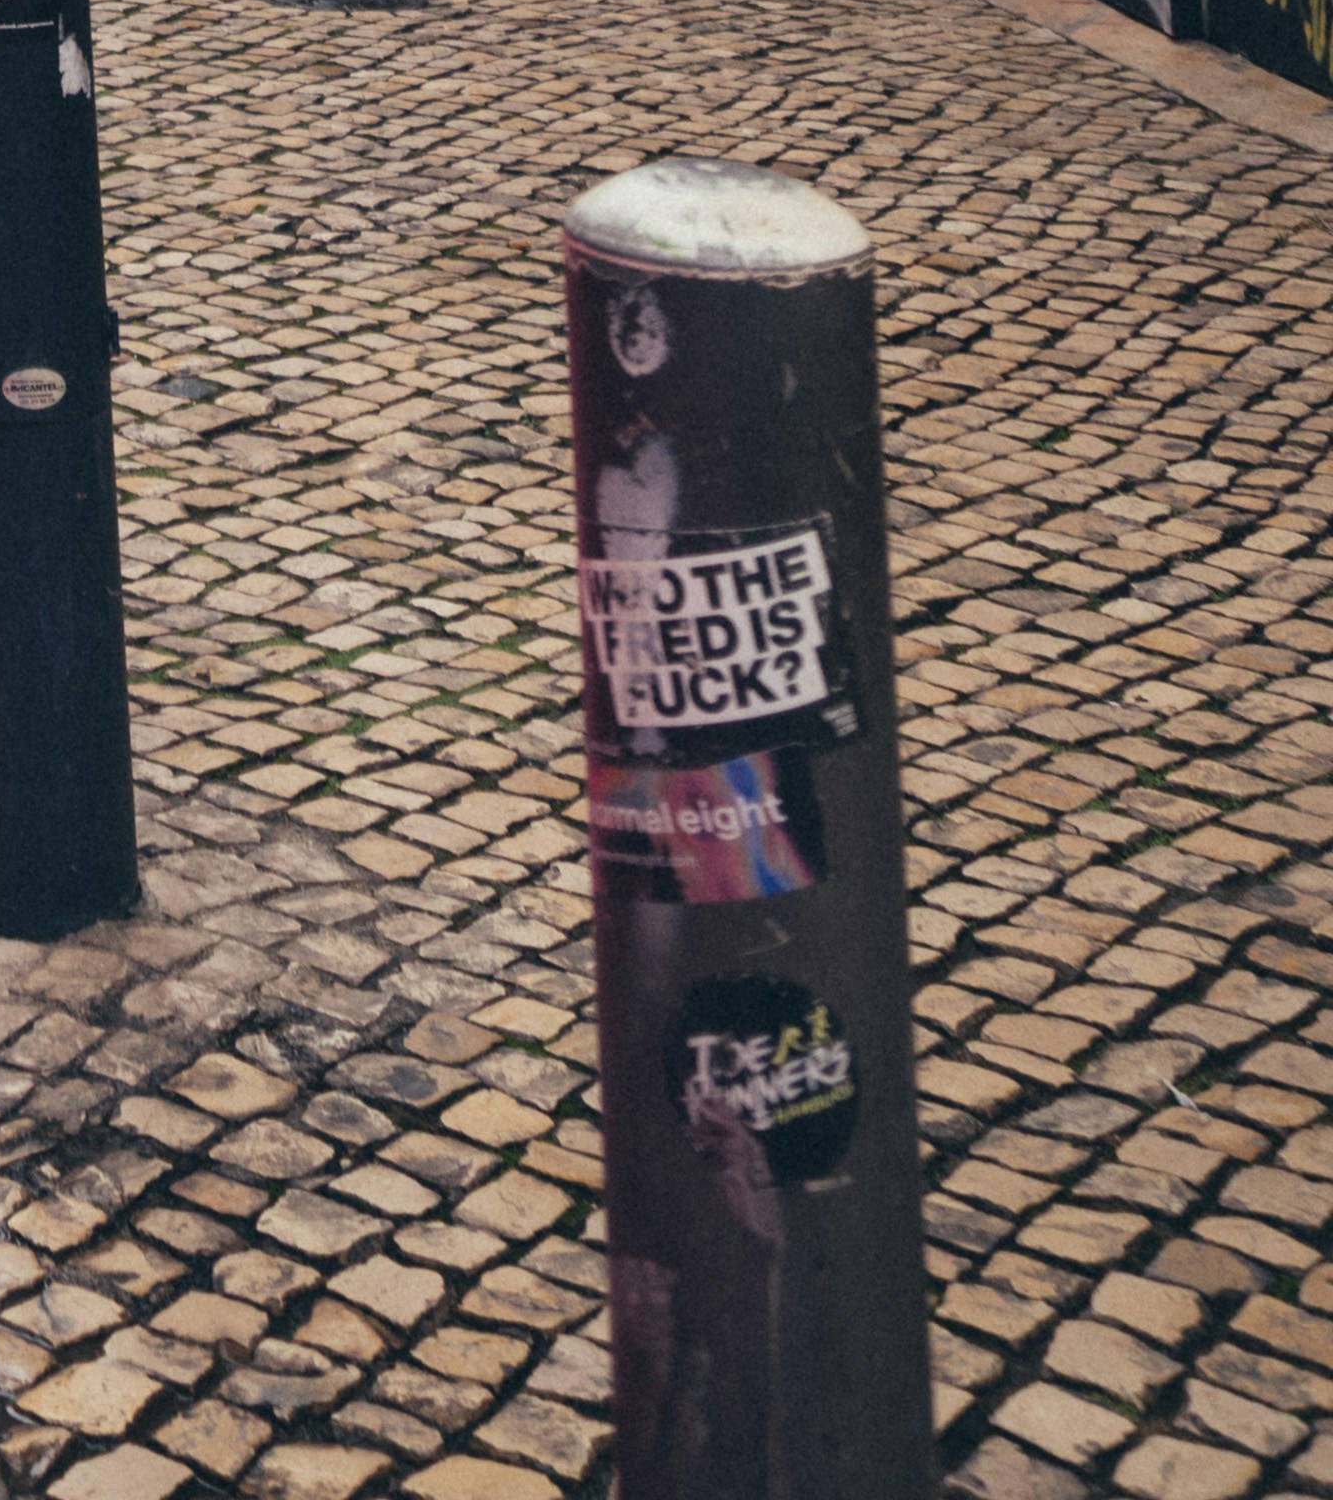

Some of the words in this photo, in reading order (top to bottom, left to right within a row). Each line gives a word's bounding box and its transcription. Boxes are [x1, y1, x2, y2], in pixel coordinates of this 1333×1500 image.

[692, 544, 812, 610] THE
[749, 600, 805, 651] IS
[677, 794, 788, 841] eight
